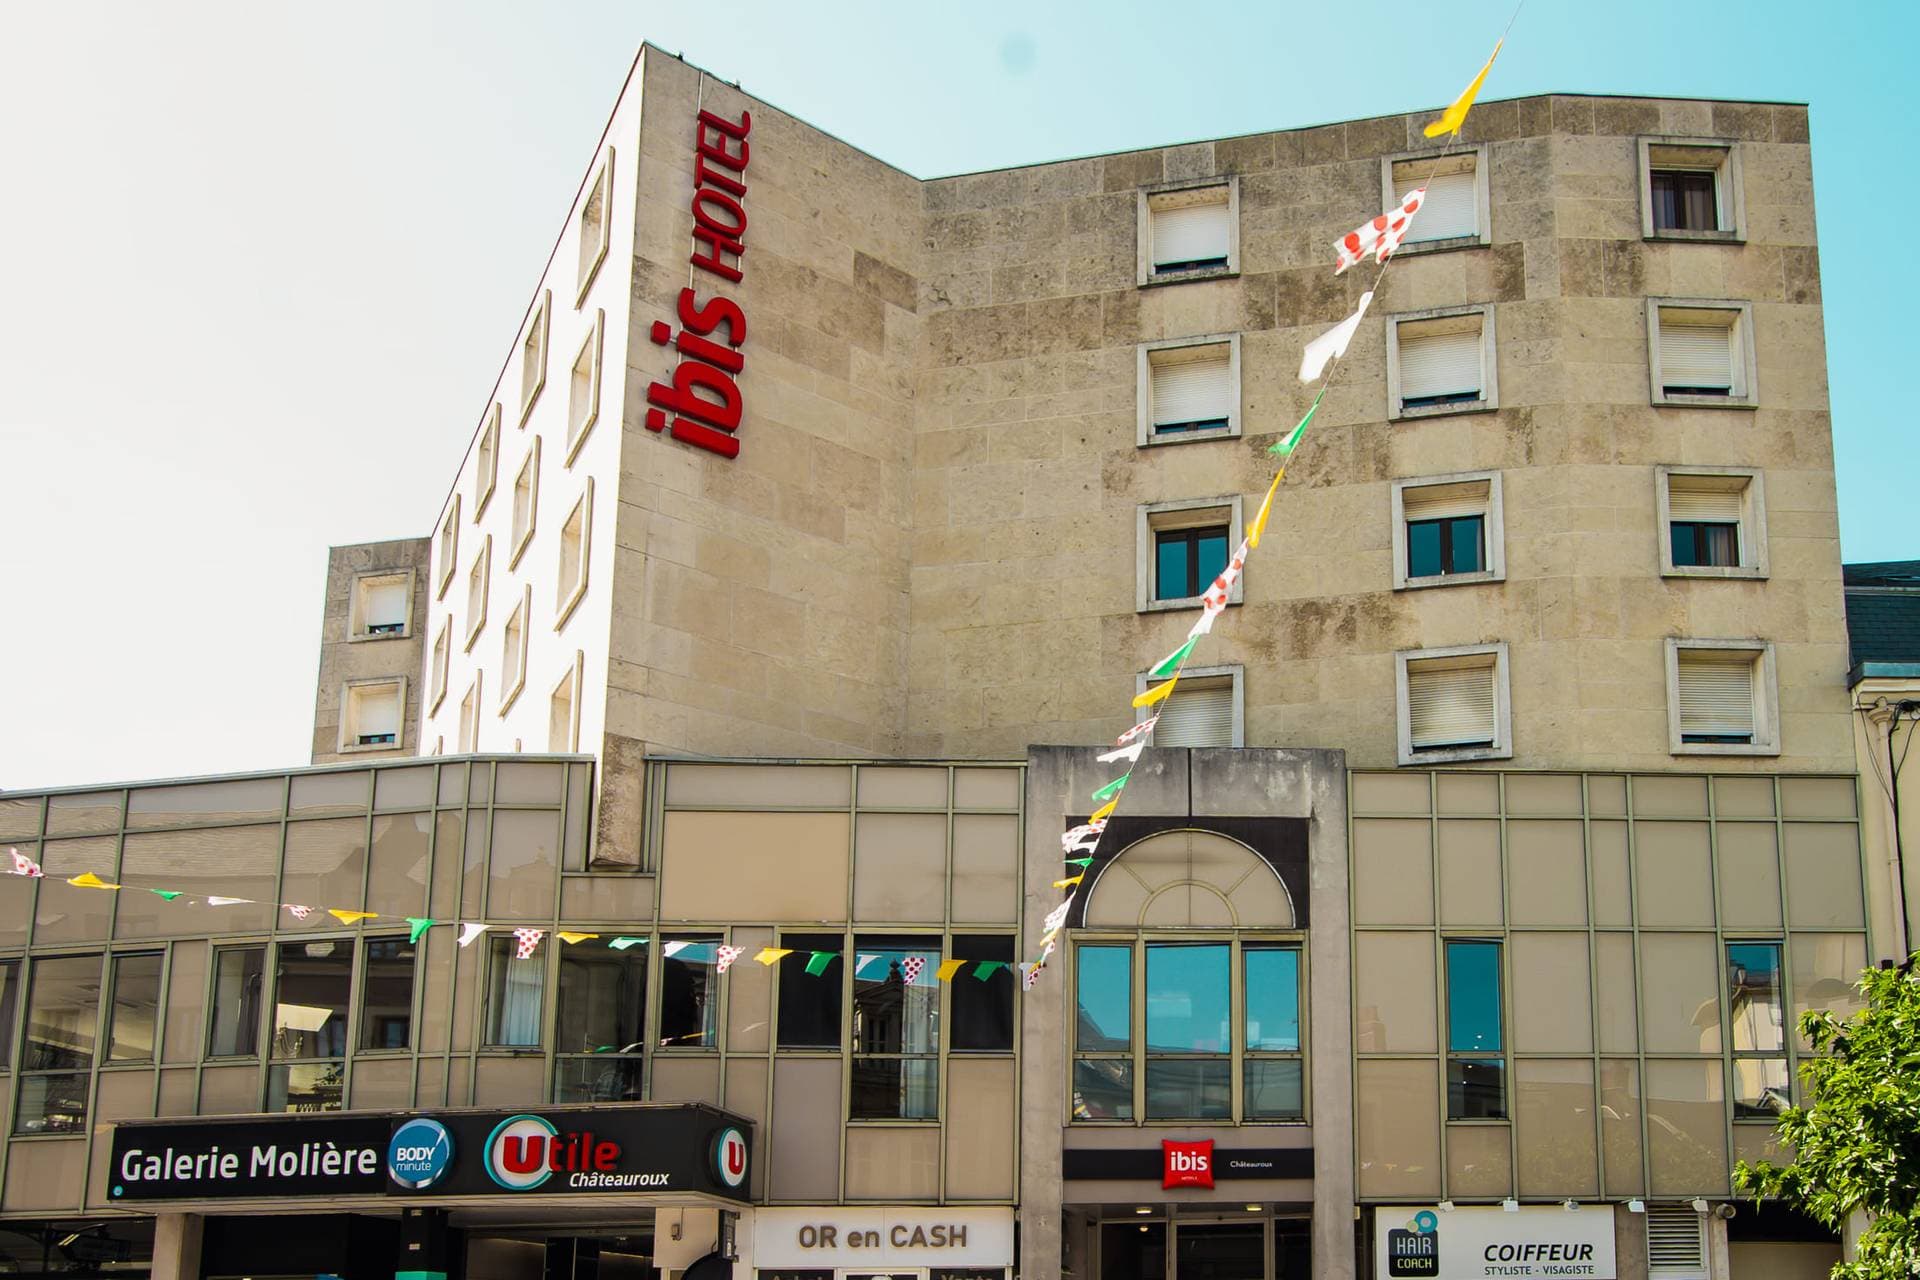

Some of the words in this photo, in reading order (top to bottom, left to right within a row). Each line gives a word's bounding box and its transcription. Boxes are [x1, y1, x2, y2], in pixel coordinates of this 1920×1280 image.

[690, 108, 751, 284] HOTEL
[645, 287, 747, 459] ibis
[121, 1146, 239, 1181] Galerie
[250, 1141, 377, 1178] Molière
[396, 1146, 436, 1161] BODY
[502, 1131, 621, 1174] Utile
[728, 1141, 744, 1175] U
[1170, 1151, 1208, 1171] ibis
[396, 1161, 431, 1171] minute
[1229, 1160, 1273, 1168] Châteauroux
[569, 1172, 670, 1188] Châteauroux
[798, 1225, 838, 1248] OR
[847, 1228, 880, 1248] en
[890, 1225, 967, 1248] CASH
[1396, 1237, 1432, 1255] HAIR
[1484, 1244, 1594, 1262] COIFFEUR
[1397, 1258, 1432, 1269] COACH
[1484, 1265, 1532, 1275] STYLISTE
[1543, 1265, 1594, 1275] VISAGISTE
